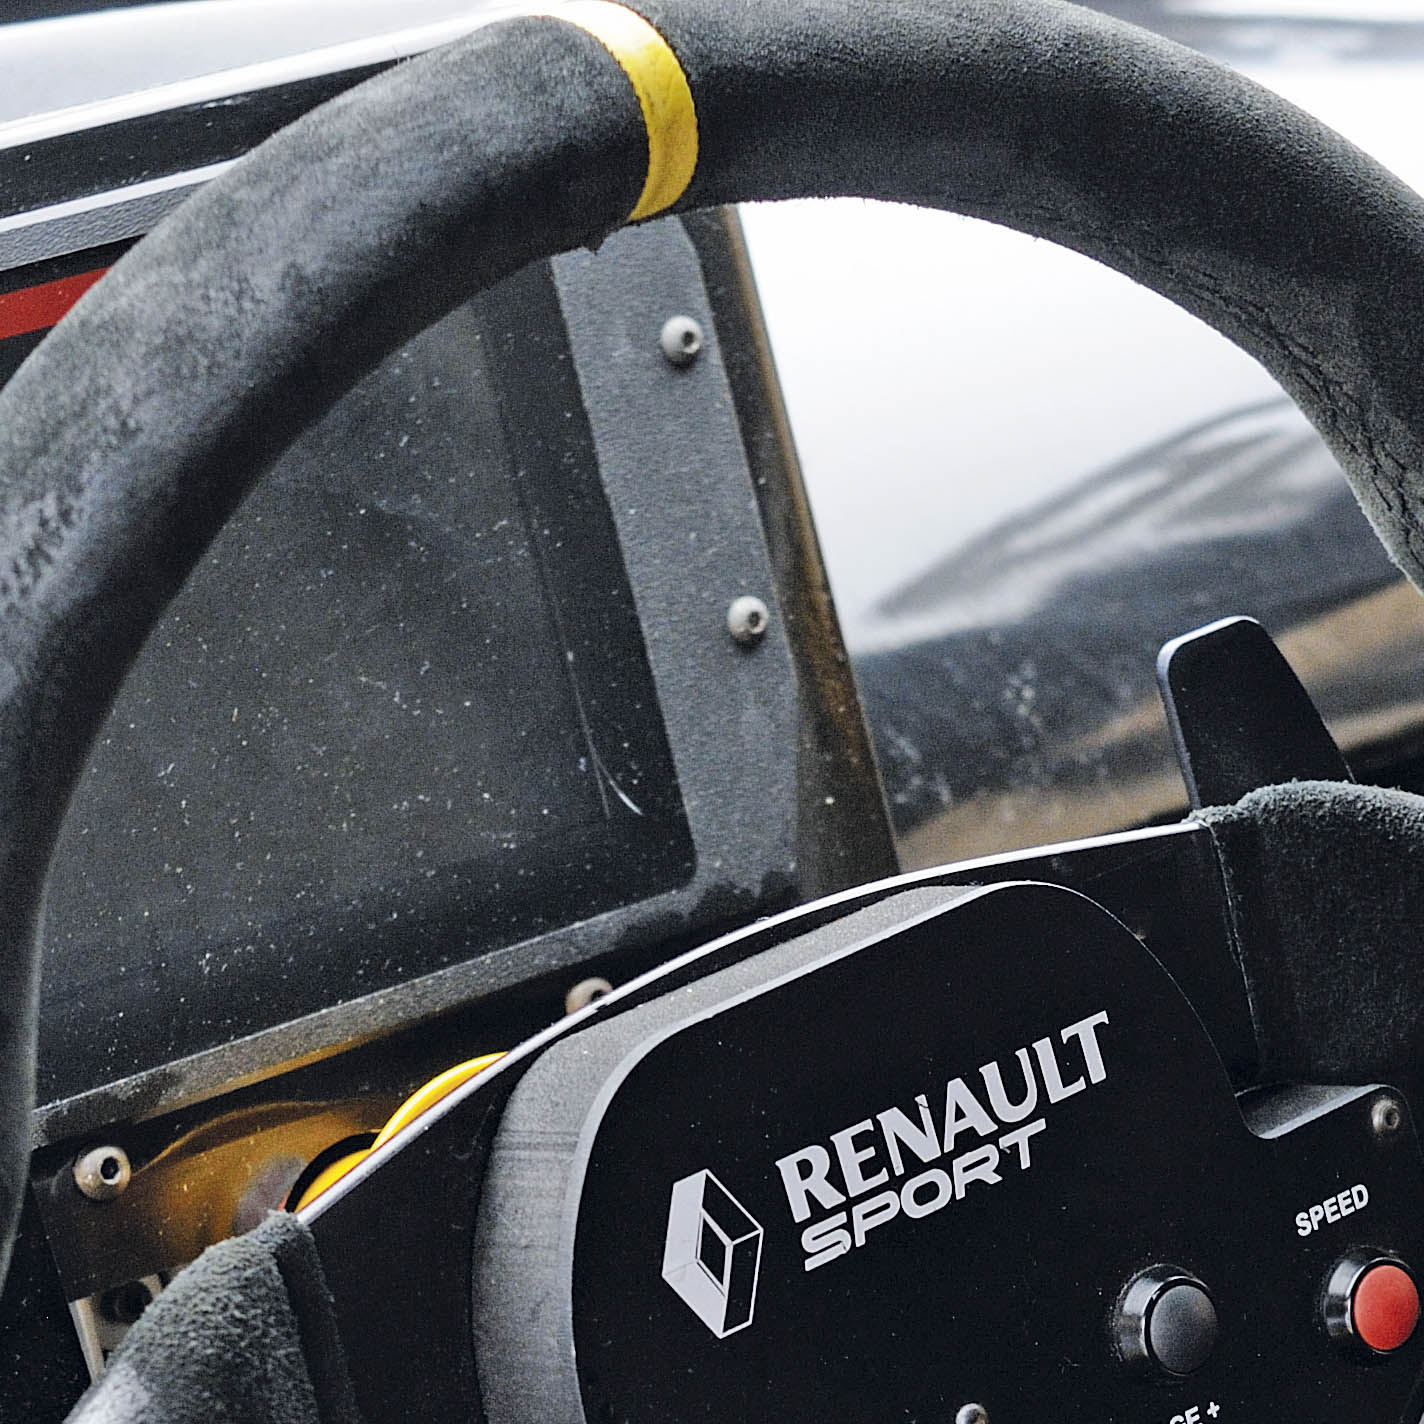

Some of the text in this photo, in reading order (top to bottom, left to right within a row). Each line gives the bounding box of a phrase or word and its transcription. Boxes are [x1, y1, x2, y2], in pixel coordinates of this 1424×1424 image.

[774, 1010, 1111, 1224] RENAULT
[800, 1117, 1048, 1272] SPORT
[1295, 1183, 1370, 1238] SPEED
